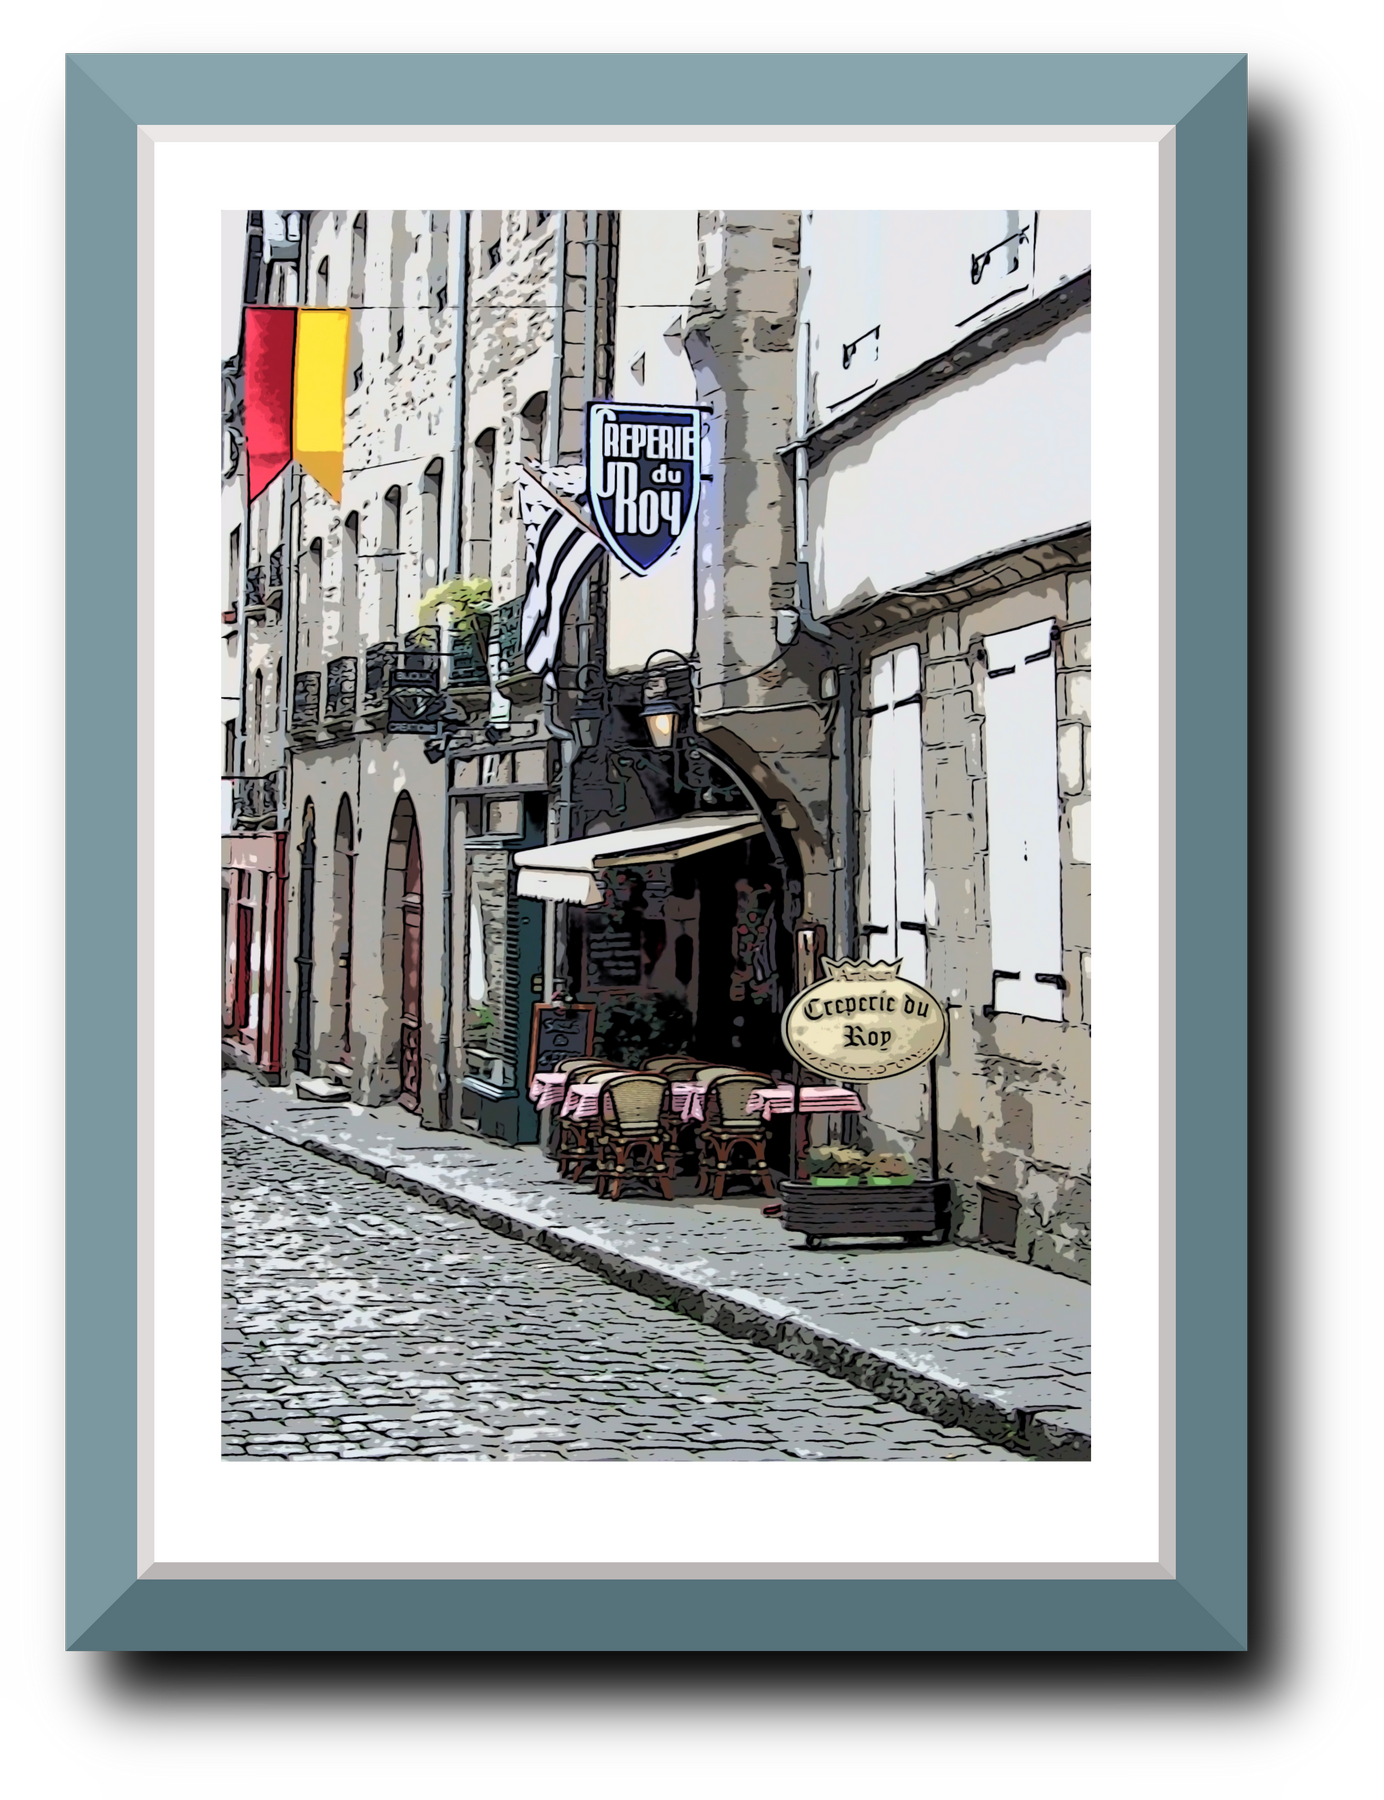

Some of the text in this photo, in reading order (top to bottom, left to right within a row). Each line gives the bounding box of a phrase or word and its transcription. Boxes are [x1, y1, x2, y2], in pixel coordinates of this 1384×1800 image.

[593, 408, 695, 460] CREPERIE
[651, 463, 682, 484] du
[614, 461, 682, 536] Roy
[804, 990, 929, 1021] Creperie du
[843, 1025, 892, 1051] Roy
